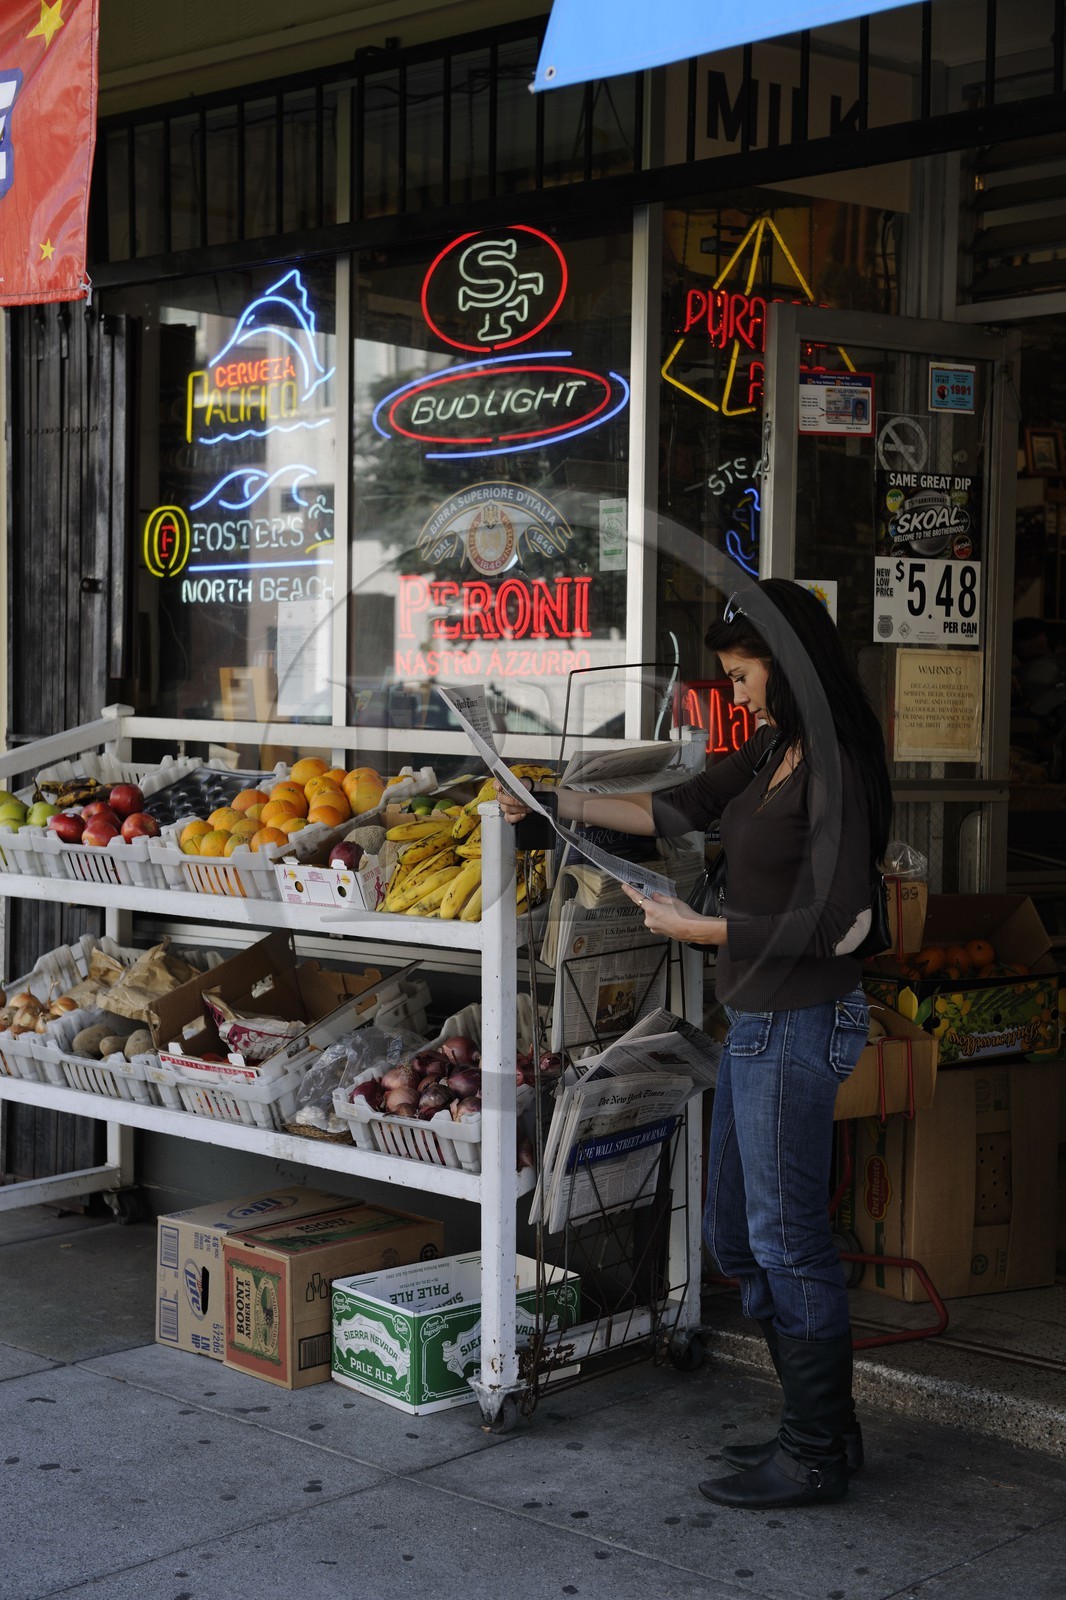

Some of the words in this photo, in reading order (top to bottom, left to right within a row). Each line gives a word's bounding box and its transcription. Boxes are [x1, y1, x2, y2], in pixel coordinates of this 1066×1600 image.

[215, 356, 296, 387] CERVEZA
[950, 384, 971, 396] 1991
[186, 371, 298, 443] PACIFICO
[889, 472, 918, 487] SAME
[920, 475, 951, 490] GREAT
[954, 477, 972, 491] DIP
[429, 503, 458, 535] BIRRA
[458, 487, 515, 508] SUPERIORE
[516, 491, 557, 527] D'ITALIA
[897, 507, 960, 534] SKOAL
[191, 516, 305, 553] FOSTER'S
[433, 538, 452, 560] DAL
[531, 531, 555, 555] 1846
[470, 520, 481, 559] BIRRA
[500, 515, 514, 559] PERONI
[894, 533, 915, 543] WELCOME
[923, 530, 932, 538] THE
[932, 525, 965, 537] BROTHERHOOD
[480, 560, 502, 571] 1846
[876, 568, 891, 577] NEW
[182, 578, 253, 604] NORTH
[260, 576, 334, 602] BEACH
[876, 577, 890, 586] LOW
[876, 587, 894, 598] PRICE
[895, 560, 977, 619] $5.48
[396, 575, 593, 640] PERONI
[943, 621, 958, 634] PER
[961, 622, 978, 634] CAN
[394, 650, 481, 677] NASTRO
[485, 648, 592, 678] AZZURRO
[918, 665, 962, 676] WARNING
[585, 908, 598, 921] THE
[615, 906, 639, 917] STREET
[948, 1021, 1041, 1057] Buttonwillow
[598, 1096, 609, 1106] The
[610, 1095, 627, 1106] New
[627, 1090, 642, 1104] York
[642, 1089, 665, 1099] Times
[595, 1142, 614, 1157] WALL
[614, 1134, 641, 1152] STREET
[640, 1126, 667, 1145] JOURNAL
[872, 1160, 880, 1196] Monte
[240, 1198, 282, 1217] Lite
[871, 1196, 879, 1215] Del
[295, 1218, 347, 1231] BOONT
[203, 1234, 211, 1243] 24
[183, 1268, 202, 1312] Lite
[389, 1289, 414, 1305] ALE
[417, 1282, 450, 1299] PALE
[236, 1277, 245, 1335] BOONT
[191, 1333, 201, 1349] HP
[201, 1335, 211, 1352] LN
[212, 1323, 220, 1354] 57205
[344, 1330, 369, 1340] SIERRA
[369, 1333, 398, 1361] NEVADA
[350, 1357, 373, 1376] PALE
[375, 1367, 394, 1385] ALE
